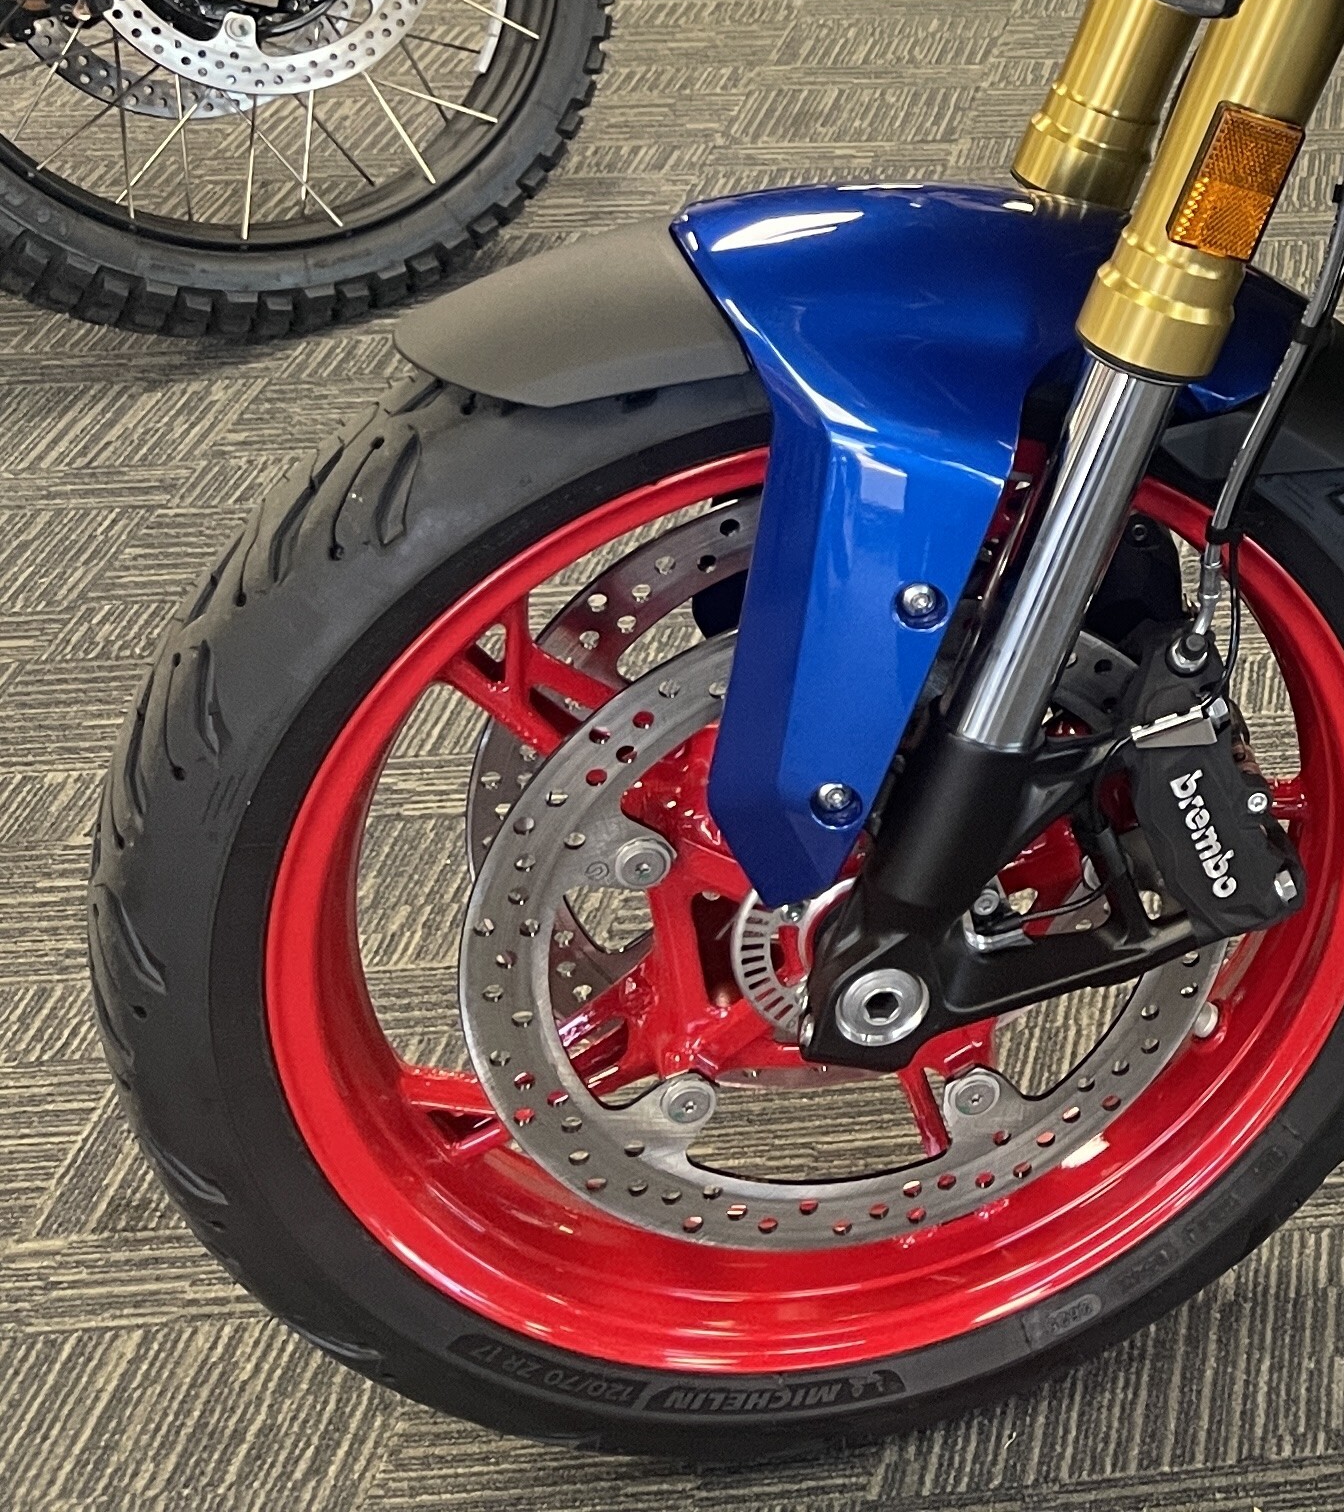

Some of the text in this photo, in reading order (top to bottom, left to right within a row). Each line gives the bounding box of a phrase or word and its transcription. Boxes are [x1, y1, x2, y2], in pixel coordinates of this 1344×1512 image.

[1169, 769, 1237, 899] brembo
[469, 1344, 843, 1412] MICHELIN 120/70 ZR 17
